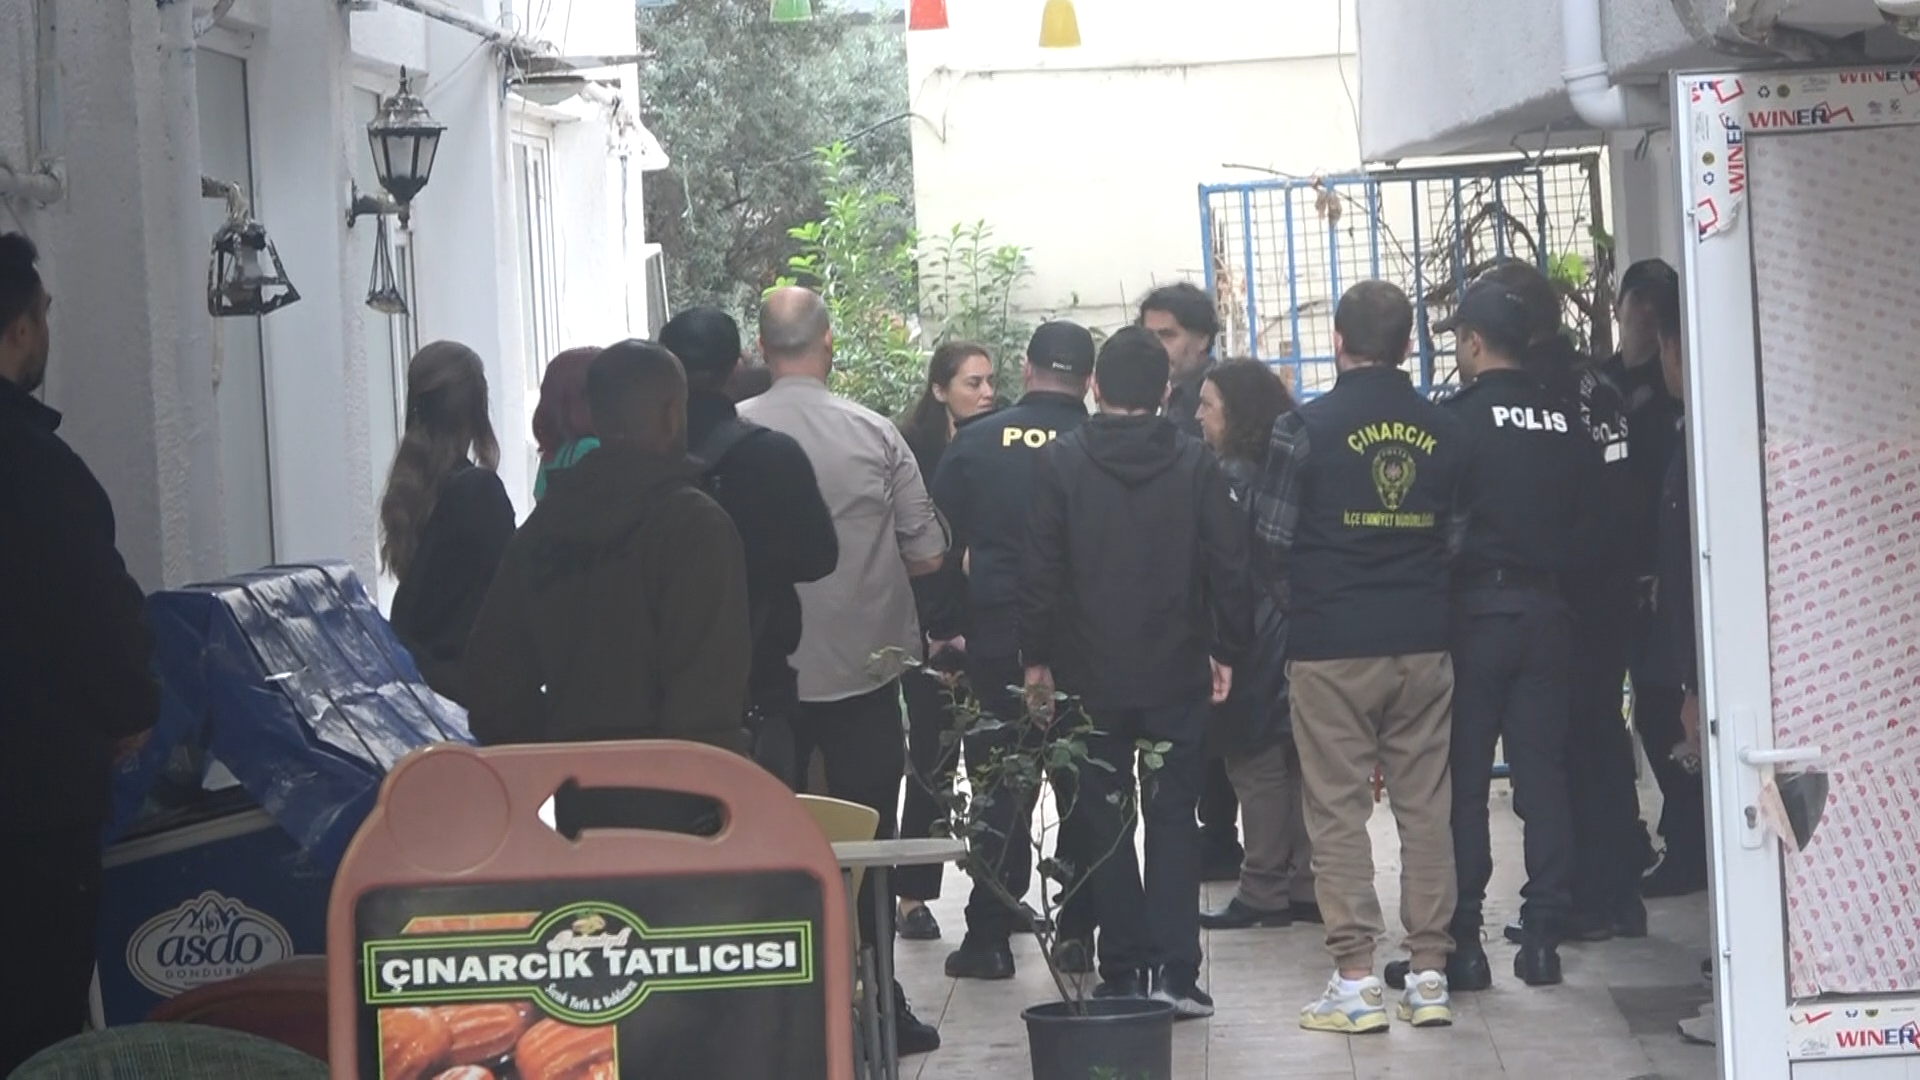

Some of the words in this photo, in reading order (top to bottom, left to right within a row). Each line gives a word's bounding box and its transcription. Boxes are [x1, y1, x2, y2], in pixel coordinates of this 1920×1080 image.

[1748, 107, 1831, 128] WINER
[1491, 405, 1568, 433] POLİS
[1347, 422, 1438, 456] ÇINARCIK
[157, 917, 263, 967] asdo
[381, 950, 594, 993] ÇINARCIK
[603, 940, 797, 976] TATLICISI
[1836, 1026, 1915, 1049] WINER
